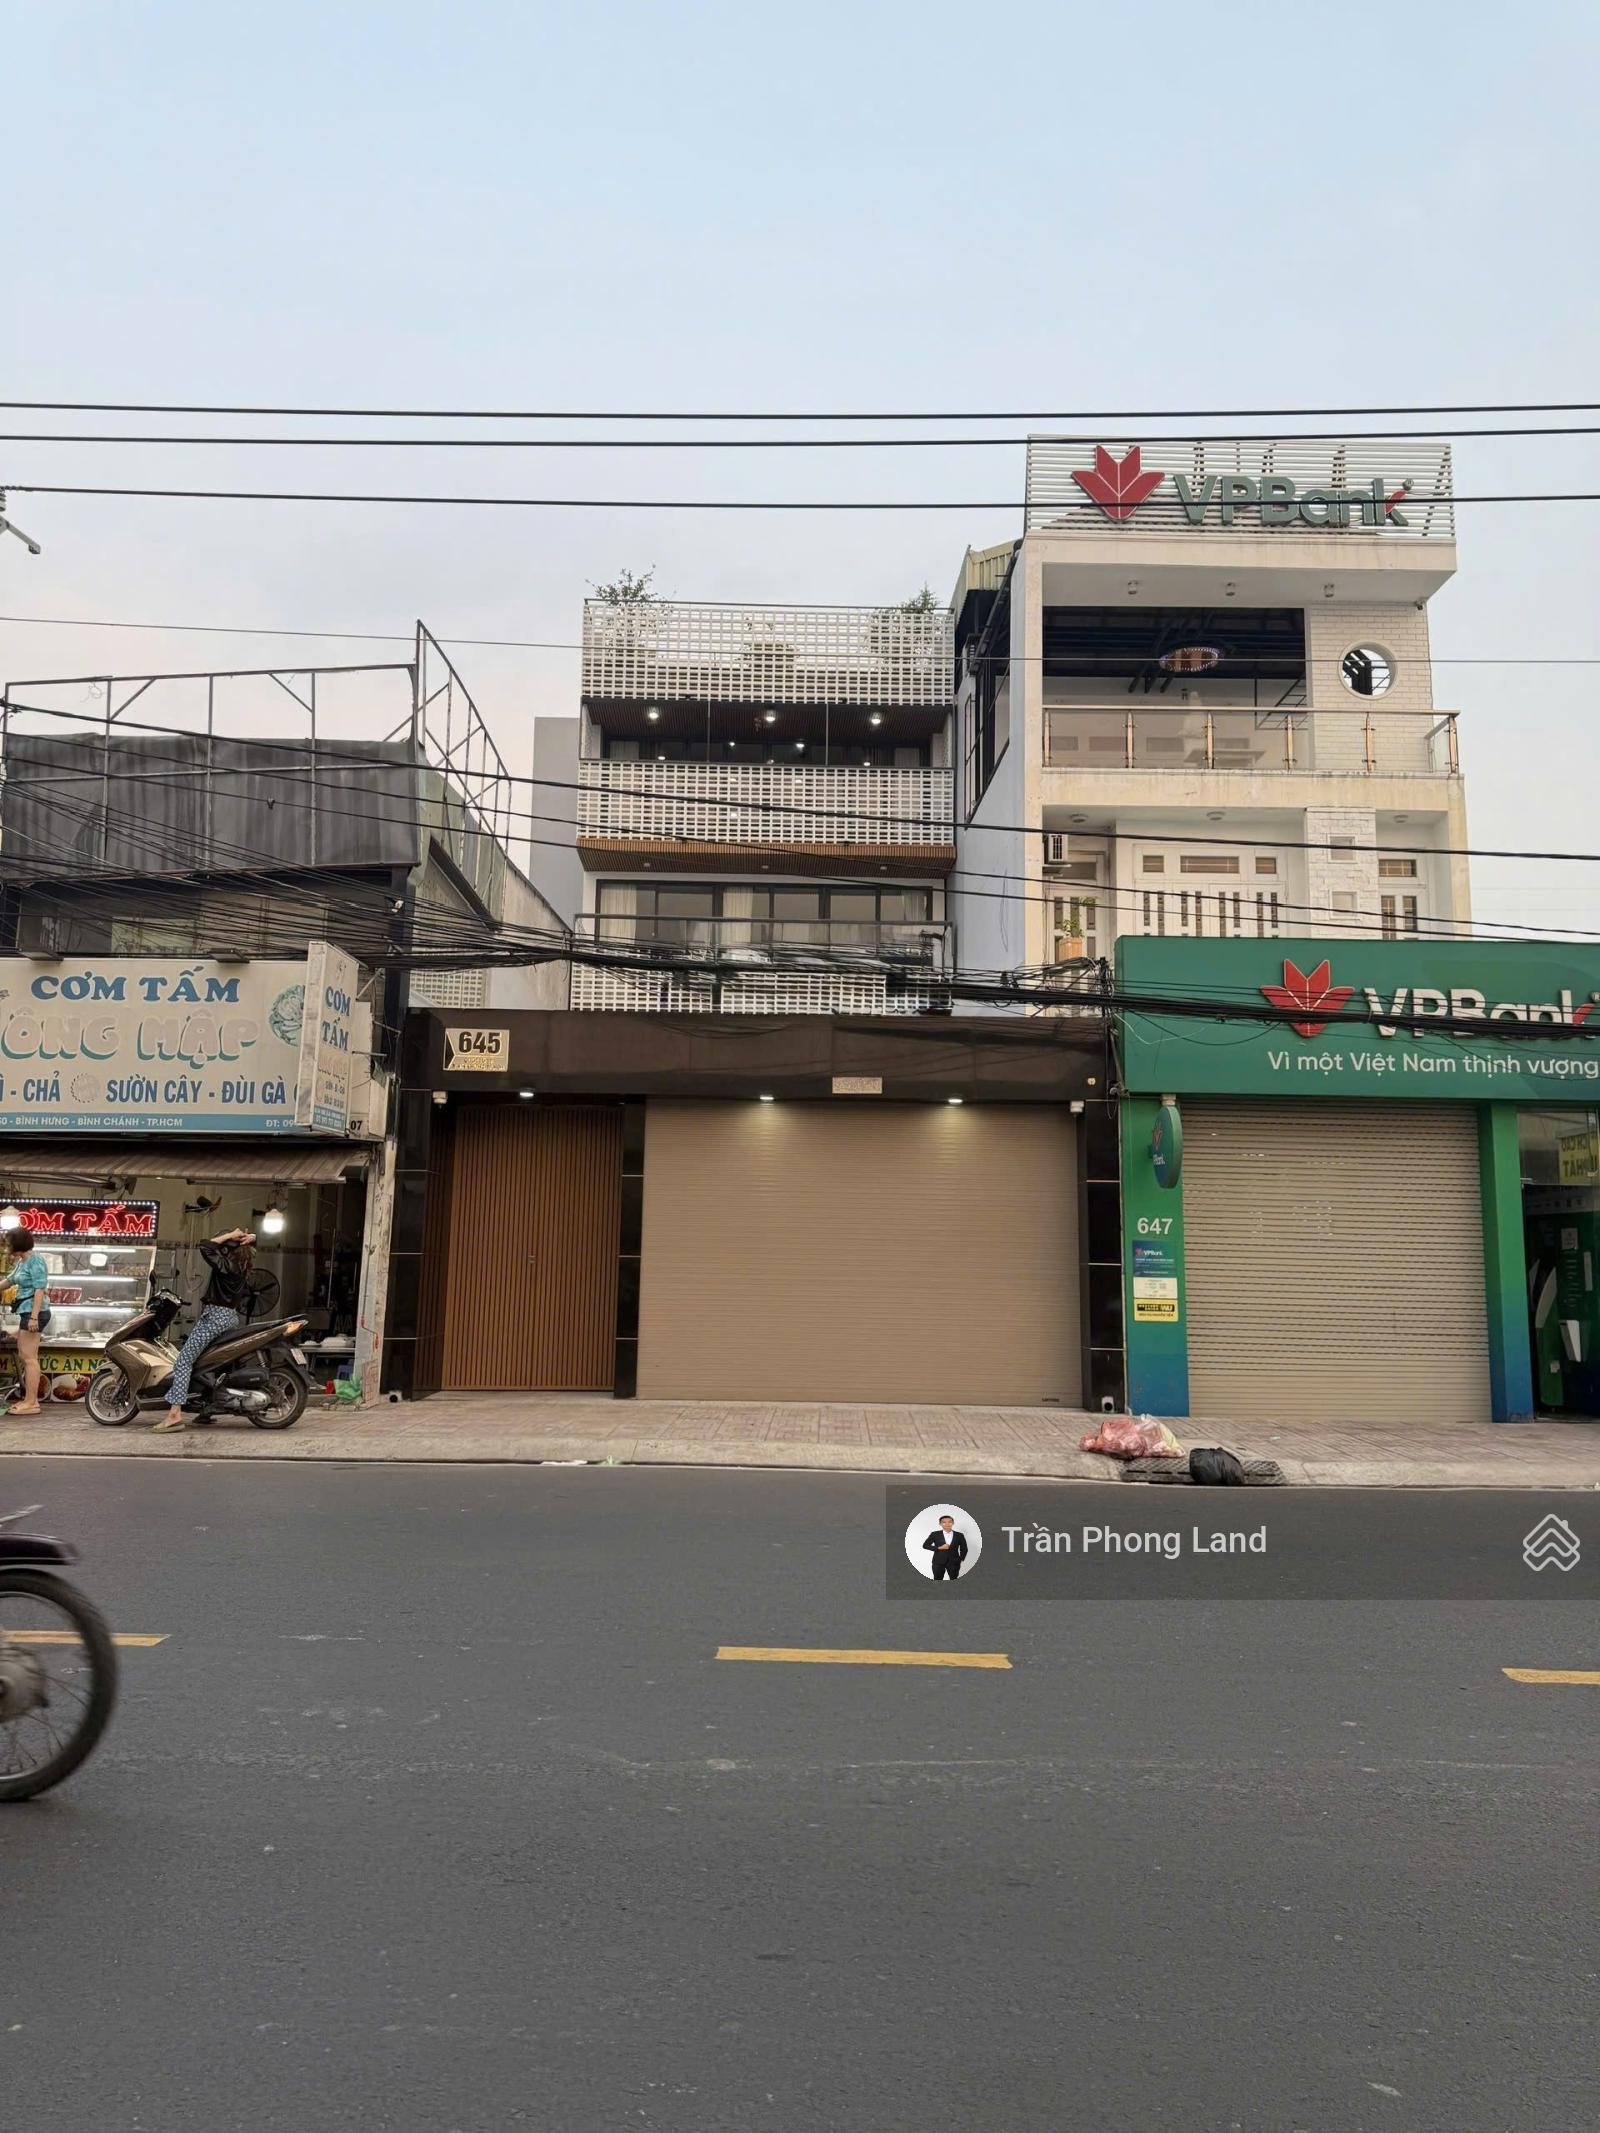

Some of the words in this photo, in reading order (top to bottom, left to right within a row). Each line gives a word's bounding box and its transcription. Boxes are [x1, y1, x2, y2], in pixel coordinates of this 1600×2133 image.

[1173, 474, 1409, 526] VPBank
[31, 971, 126, 1001] CƠM
[139, 966, 241, 1002] TẤM
[325, 986, 351, 1016] CƠM
[1363, 988, 1595, 1038] VPBank
[322, 1017, 349, 1051] TẤM
[458, 1031, 502, 1054] 645
[1267, 1051, 1290, 1070] Vì
[1297, 1052, 1344, 1076] một
[1349, 1052, 1396, 1077] Việt
[1403, 1053, 1457, 1073] Nam
[1463, 1055, 1521, 1078] thịnh
[1527, 1059, 1600, 1080] vượng
[23, 1070, 61, 1102] CHẢ
[105, 1073, 158, 1103] SƯỜN
[164, 1074, 202, 1103] CÂY
[221, 1075, 255, 1104] ĐÙI
[261, 1075, 286, 1105] GÀ
[15, 1115, 38, 1125] BÌNH
[78, 1115, 100, 1126] BÌNH
[72, 1204, 152, 1233] TẤM
[1137, 1217, 1173, 1235] 647
